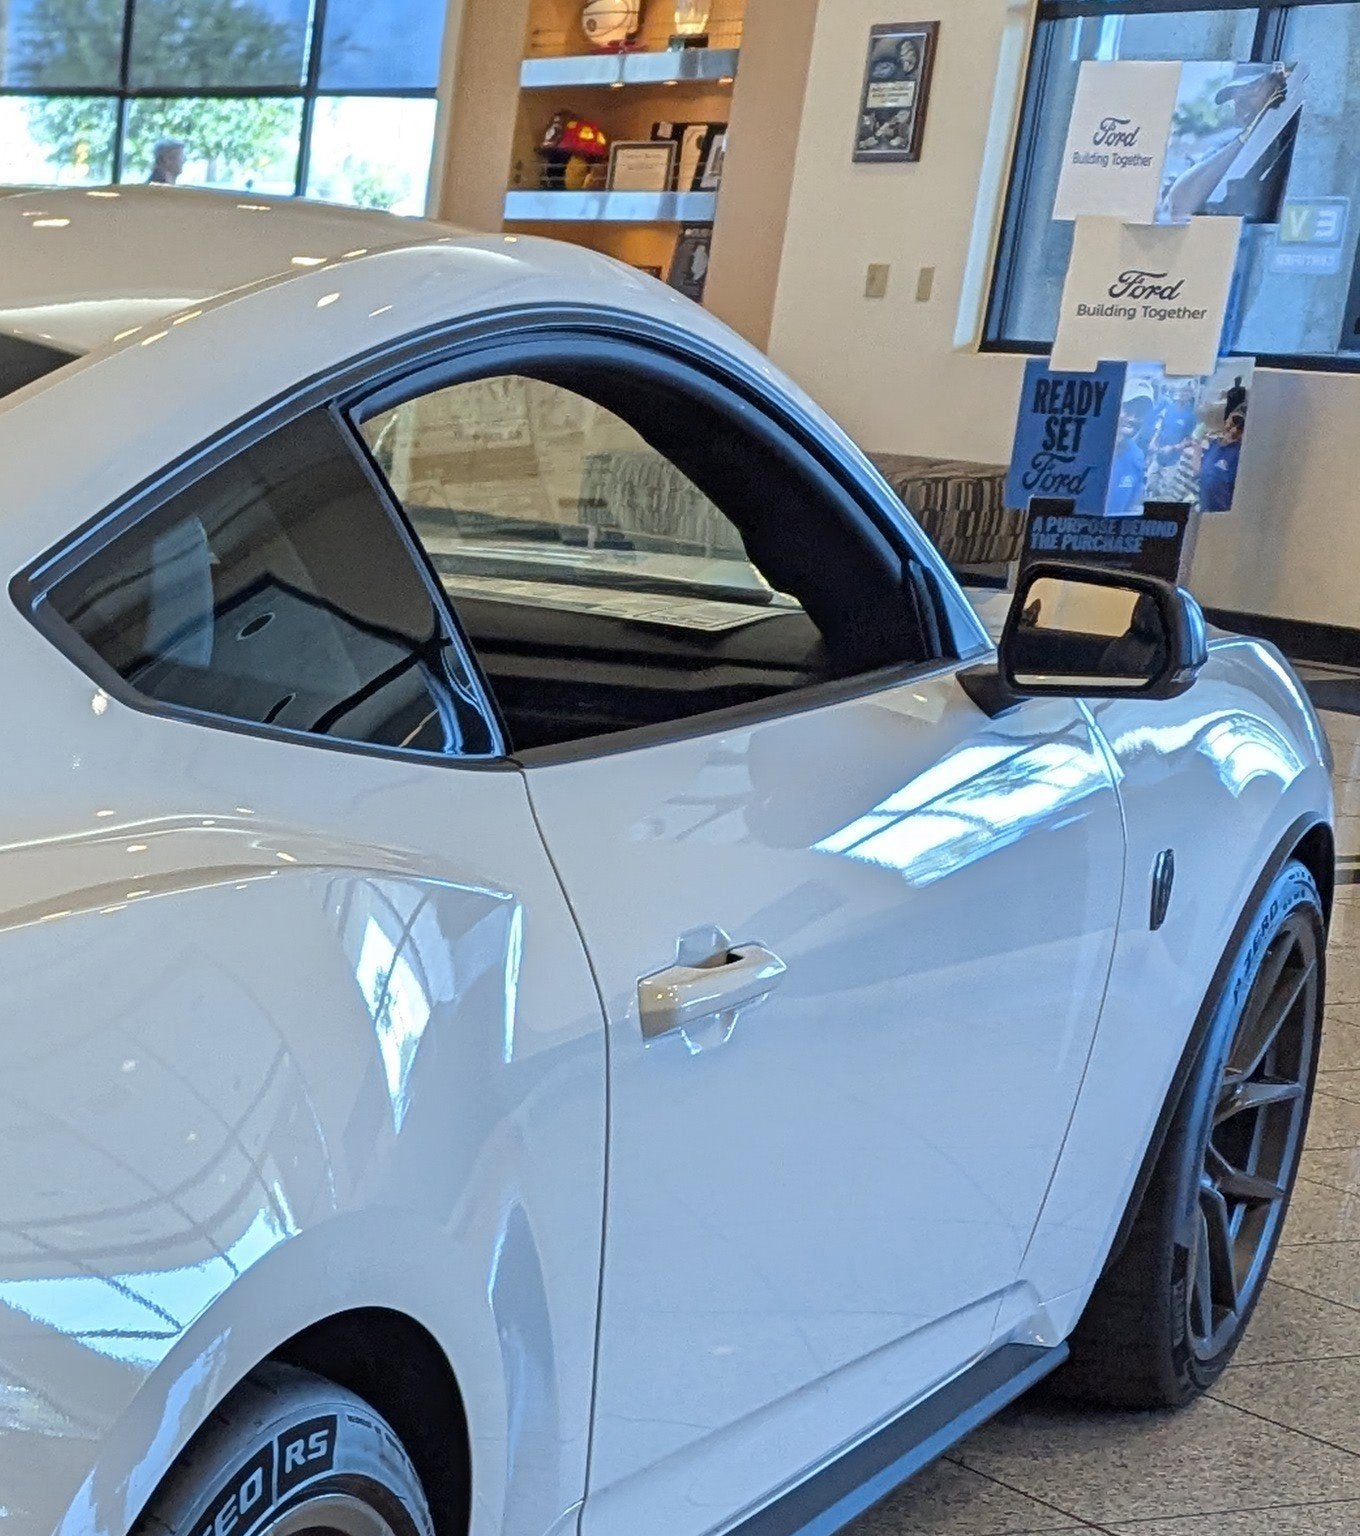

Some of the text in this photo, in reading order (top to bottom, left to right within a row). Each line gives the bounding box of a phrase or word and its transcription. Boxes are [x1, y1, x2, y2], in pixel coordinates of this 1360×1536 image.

[1092, 117, 1141, 147] Ford
[1072, 151, 1153, 168] Building Together
[1108, 270, 1185, 300] Ford
[1076, 304, 1207, 321] Building Together
[1032, 378, 1110, 417] READY
[1042, 415, 1087, 452] SET
[1022, 451, 1098, 495] Ford
[1032, 515, 1179, 538] A PURPOSE BEHIND
[1031, 532, 1144, 554] THE PURCHASE
[283, 1428, 331, 1474] RS
